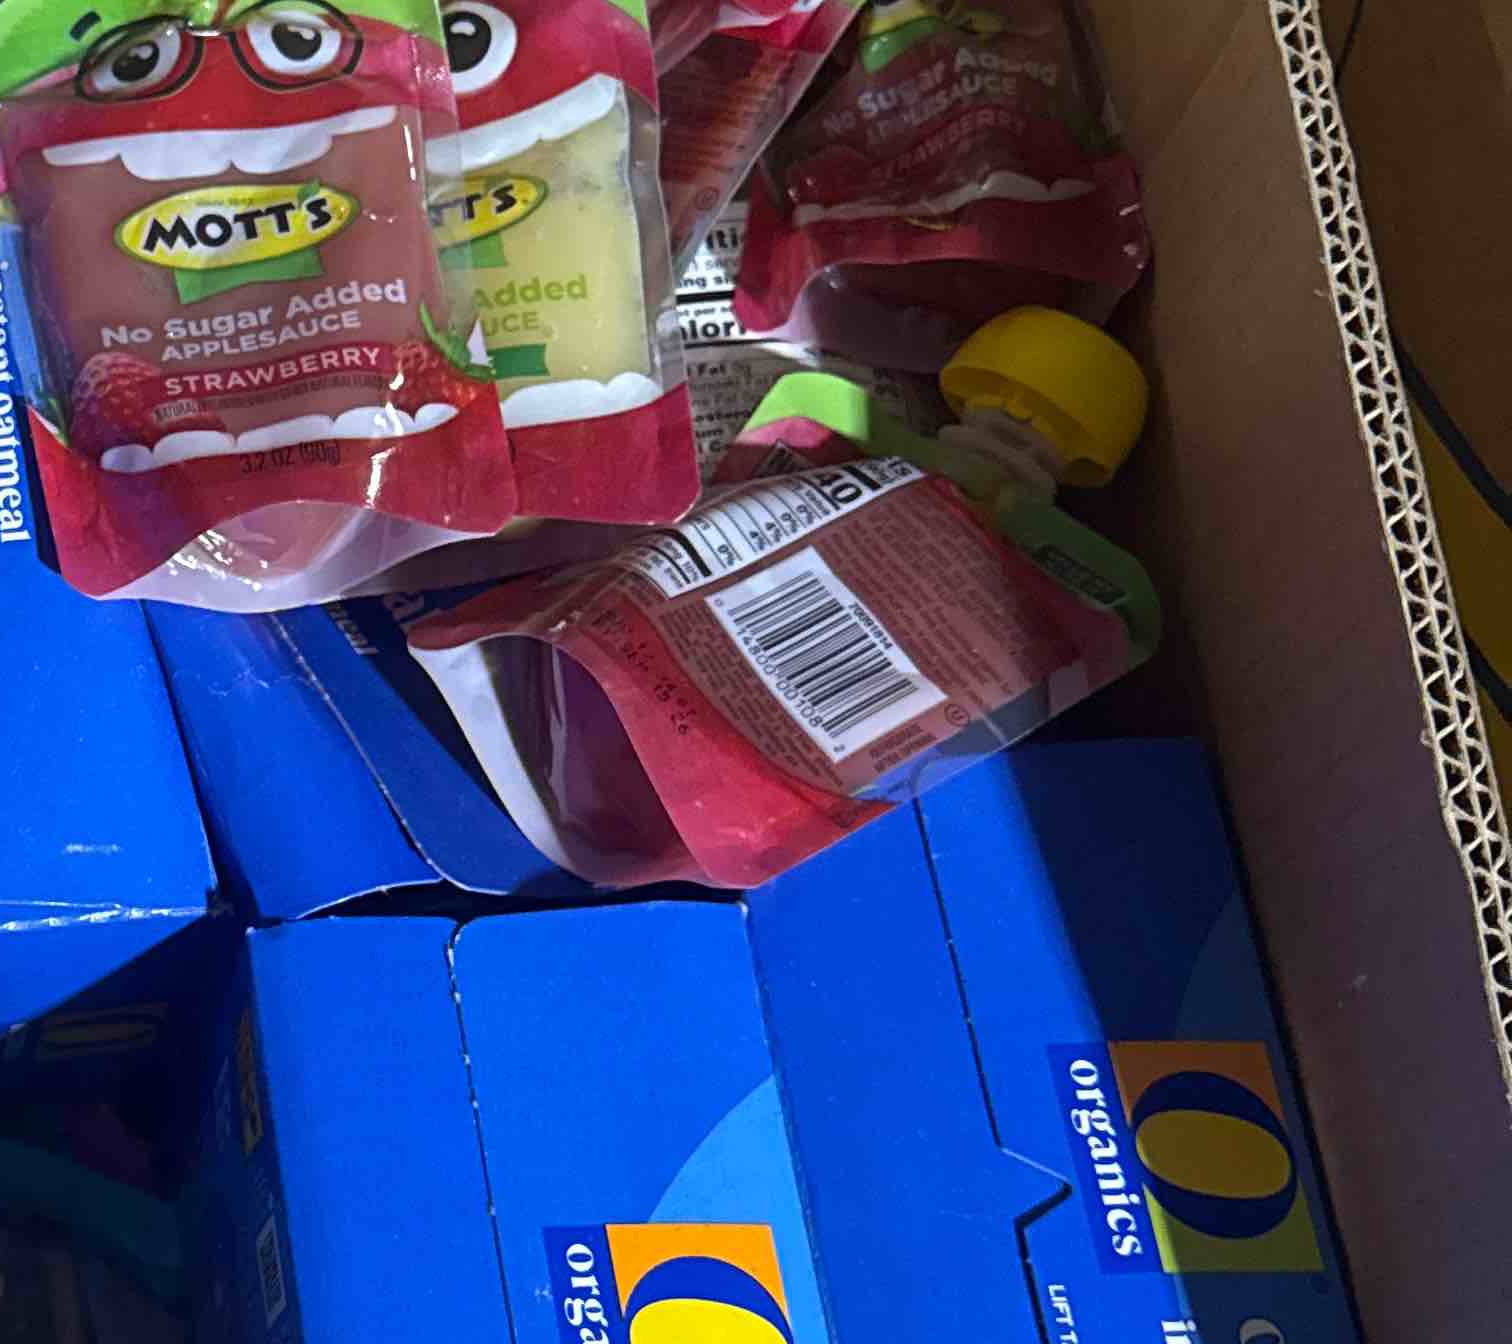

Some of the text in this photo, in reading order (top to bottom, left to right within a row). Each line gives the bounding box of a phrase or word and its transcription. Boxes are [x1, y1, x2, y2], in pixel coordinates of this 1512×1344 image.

[856, 56, 947, 119] Sugar
[99, 274, 408, 350] No Sugar Added
[471, 273, 590, 312] Added
[159, 308, 364, 363] APPLESAUCE
[164, 344, 383, 397] STRAWBERRY
[1068, 1058, 1144, 1257] organics
[1048, 1283, 1075, 1329] LIFT
